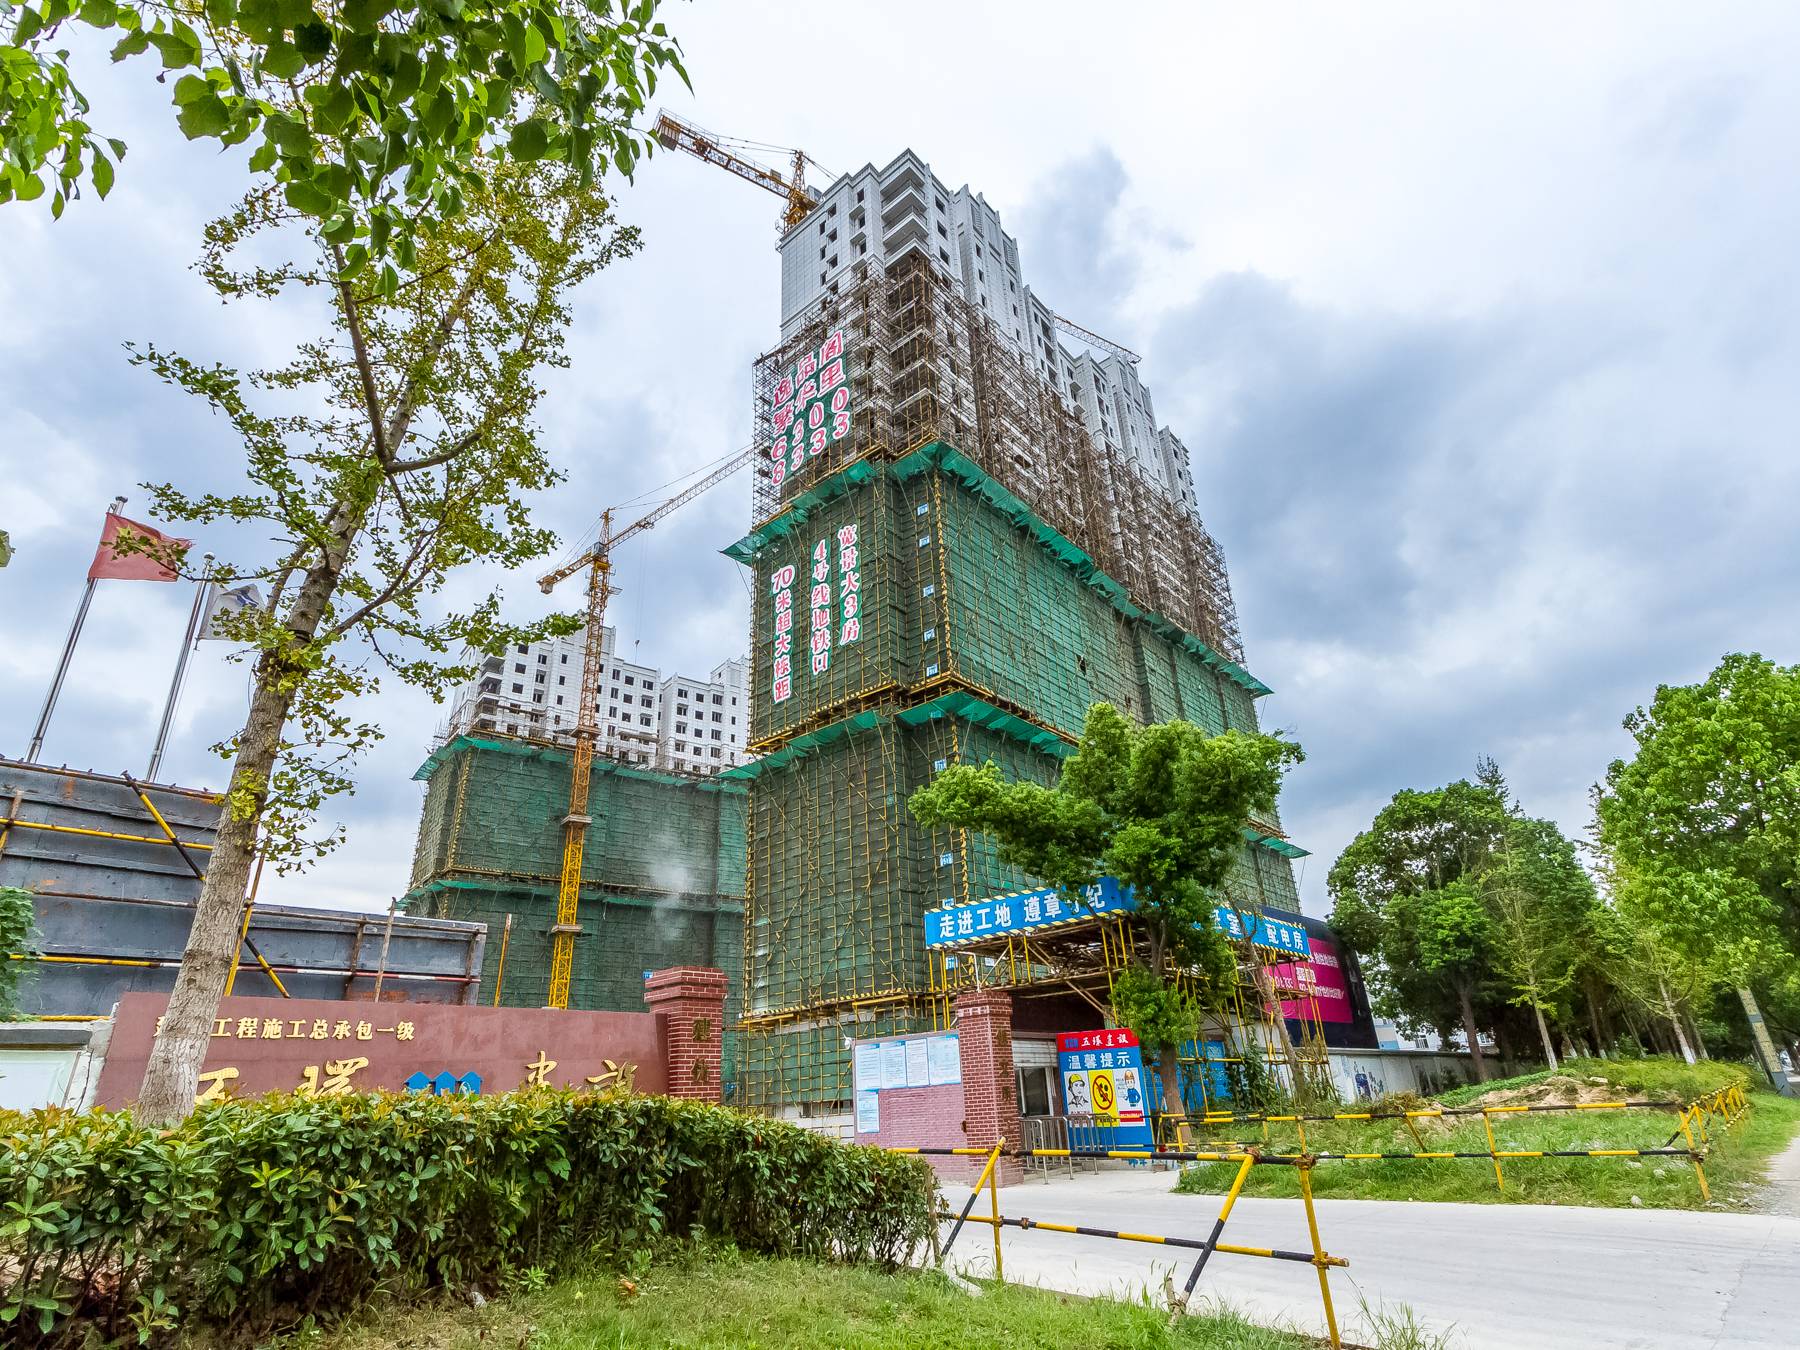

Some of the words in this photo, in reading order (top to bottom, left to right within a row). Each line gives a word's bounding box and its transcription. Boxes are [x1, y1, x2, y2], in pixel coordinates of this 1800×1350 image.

[771, 387, 849, 461] 6300
[771, 411, 850, 486] 8333
[811, 539, 830, 675] 4号线地铁口
[939, 902, 1012, 938] 走进工地
[1265, 923, 1304, 951] 配电房
[153, 1016, 416, 1042] 工程施工总承包一级
[1068, 1051, 1131, 1070] 温馨提示
